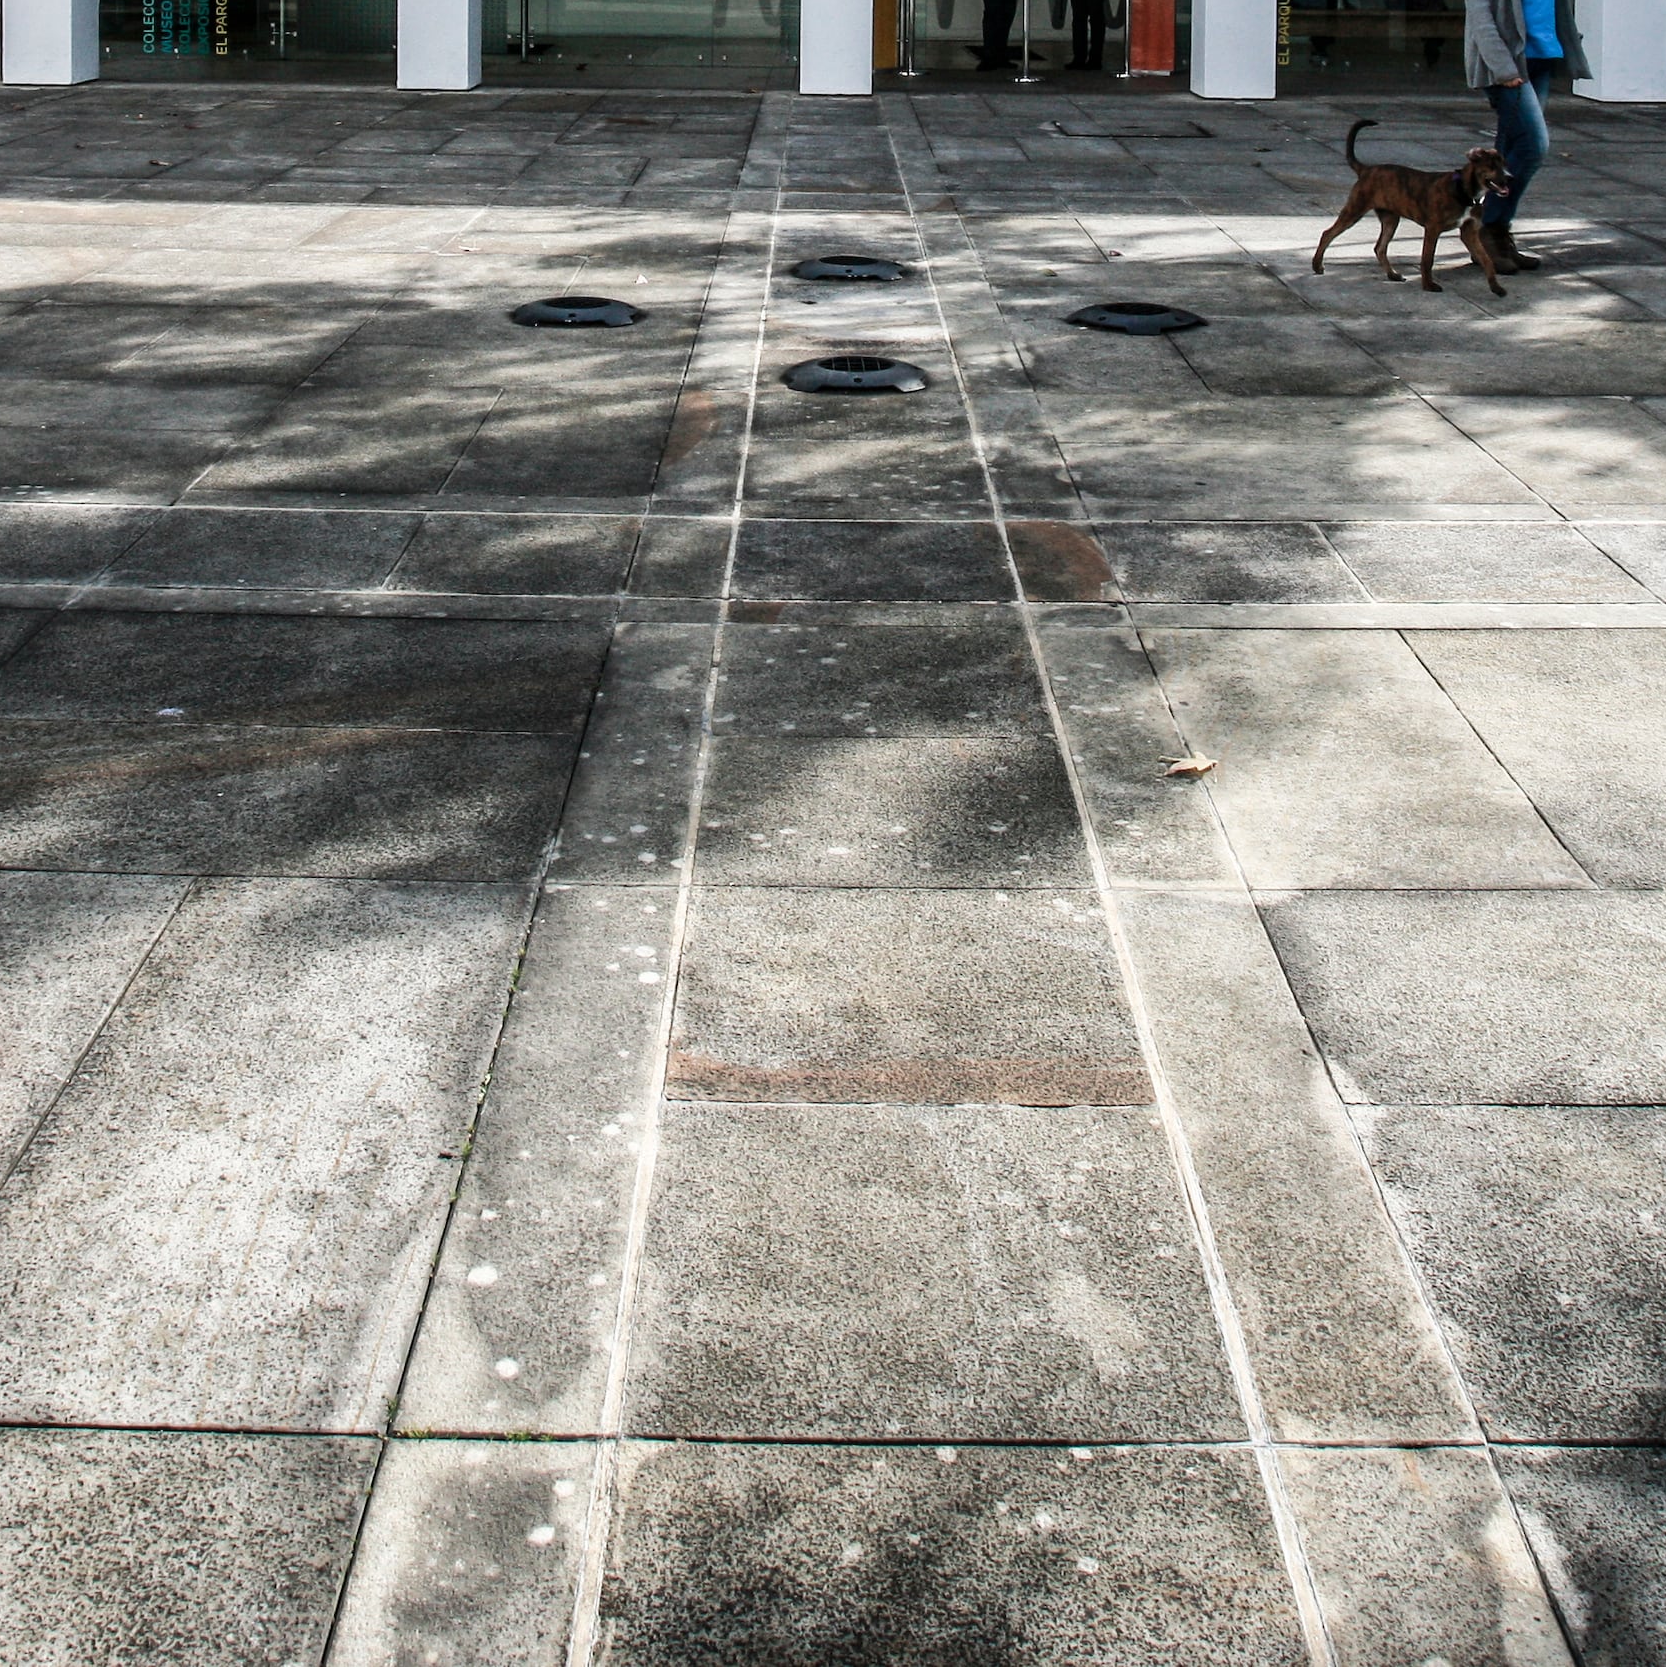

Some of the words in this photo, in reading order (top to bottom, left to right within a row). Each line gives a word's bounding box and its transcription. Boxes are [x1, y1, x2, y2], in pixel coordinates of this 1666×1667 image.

[161, 0, 173, 54] MUSEO
[216, 37, 228, 55] EL
[1277, 48, 1290, 66] EL
